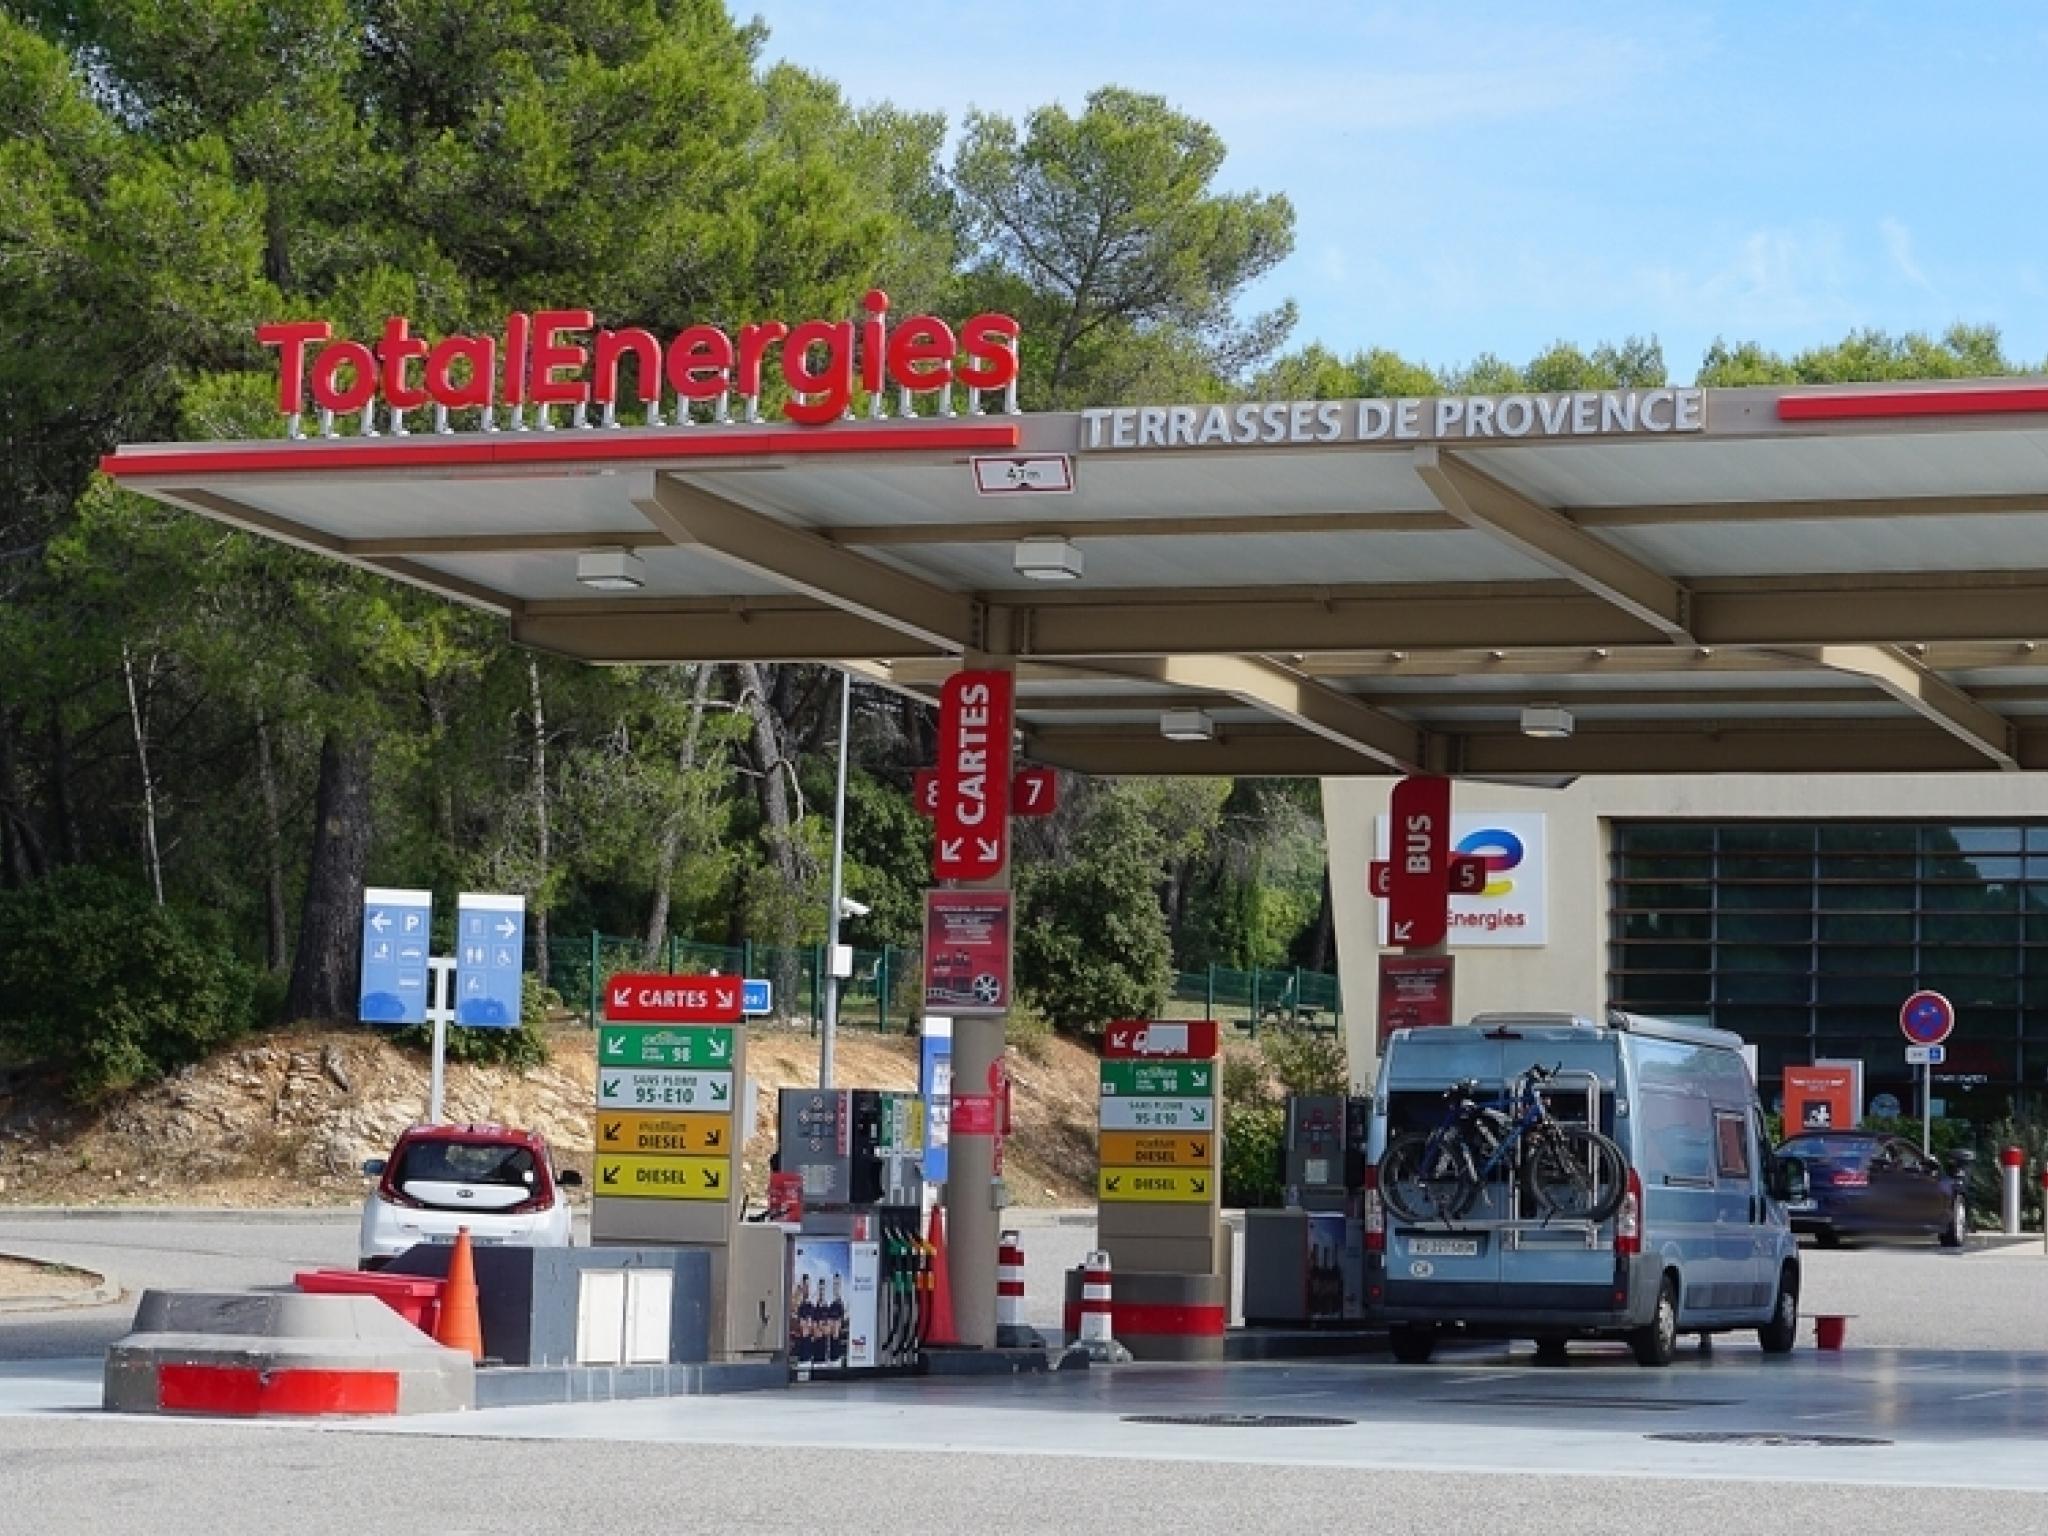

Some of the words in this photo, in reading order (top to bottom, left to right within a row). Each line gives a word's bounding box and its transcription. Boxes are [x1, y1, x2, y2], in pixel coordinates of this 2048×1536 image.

[256, 289, 1020, 423] TotalEnergies
[1082, 404, 1342, 448] TERRASSES
[1358, 402, 1421, 441] DE
[1436, 388, 1705, 437] PROVENCE
[956, 683, 989, 825] CARTES
[1026, 779, 1043, 806] 7
[1406, 815, 1431, 873] BUS
[1461, 864, 1475, 888] 5
[406, 916, 419, 931] P
[638, 989, 708, 1008] CARTES
[672, 1047, 692, 1062] 98
[636, 1088, 695, 1103] 95-E10
[639, 1135, 687, 1149] DIESEL
[1136, 1151, 1176, 1163] DIESEL
[636, 1168, 687, 1185] DIESEL
[1133, 1178, 1176, 1192] DIESEL
